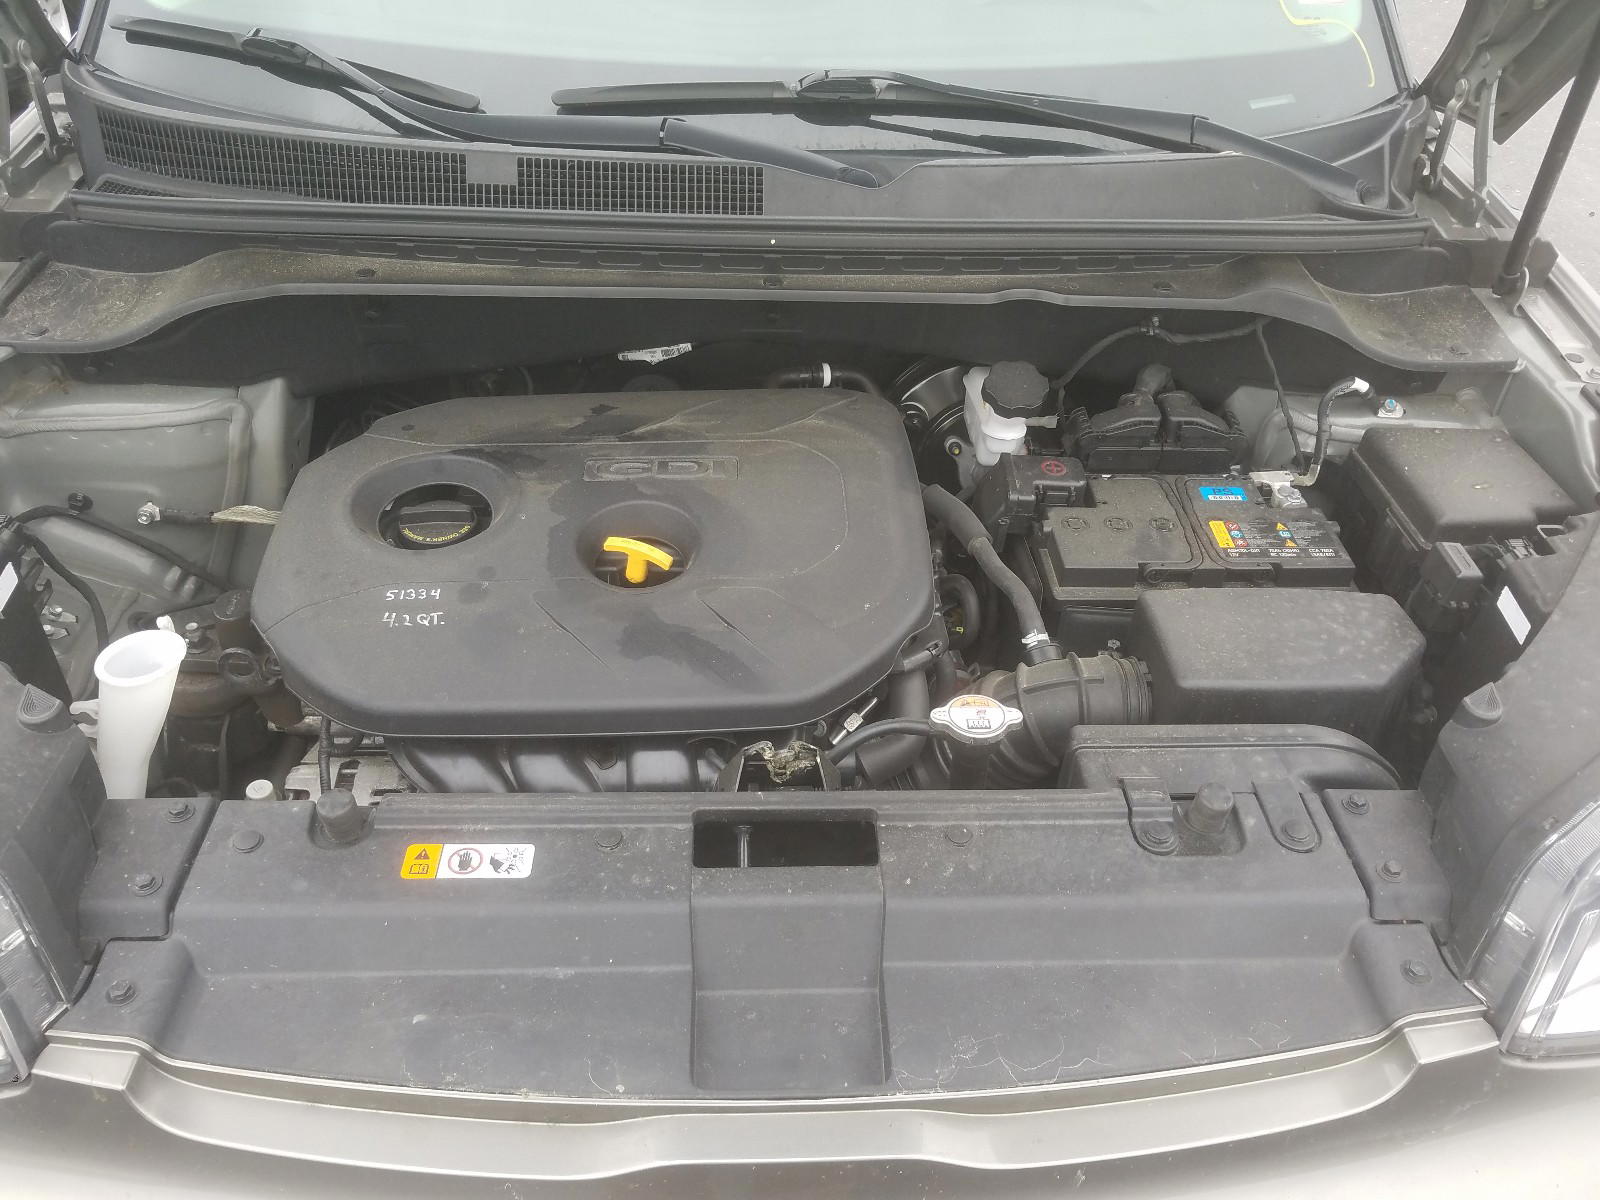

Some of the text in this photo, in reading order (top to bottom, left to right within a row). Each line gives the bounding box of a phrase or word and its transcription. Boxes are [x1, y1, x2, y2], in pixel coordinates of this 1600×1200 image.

[425, 532, 459, 542] OWNER'S
[385, 588, 441, 601] 51334
[381, 610, 446, 628] 4.2 QT.
